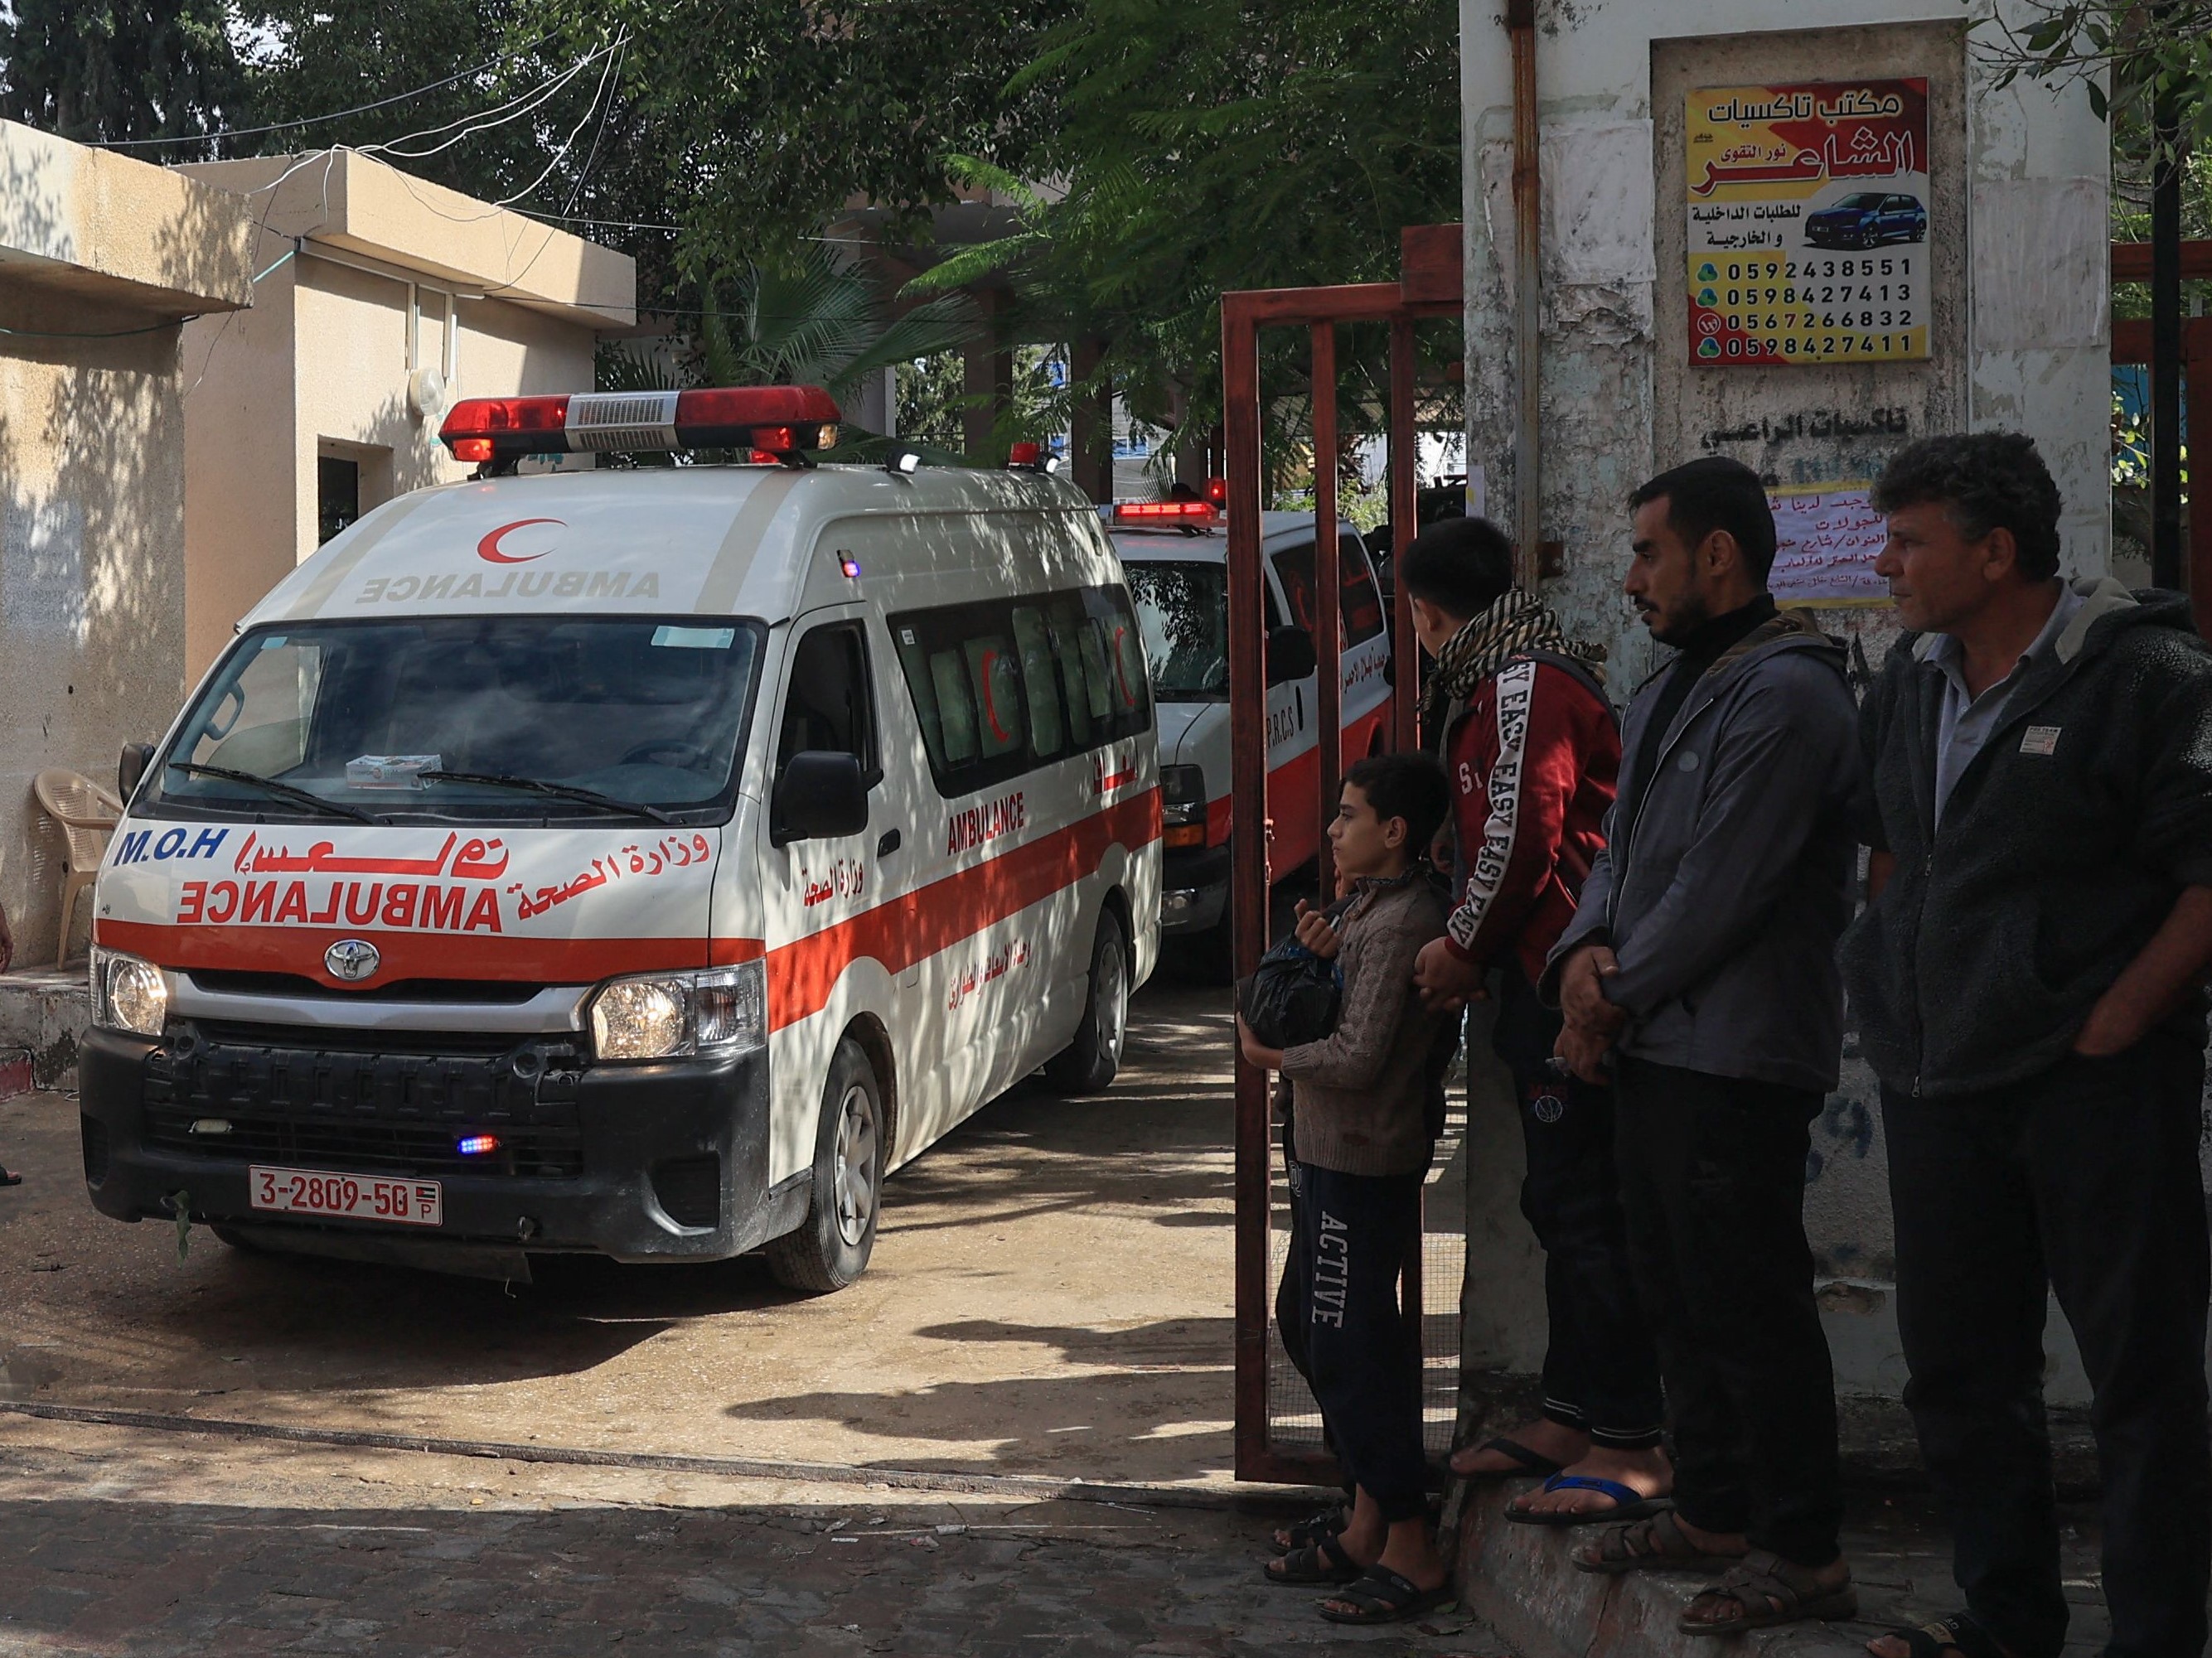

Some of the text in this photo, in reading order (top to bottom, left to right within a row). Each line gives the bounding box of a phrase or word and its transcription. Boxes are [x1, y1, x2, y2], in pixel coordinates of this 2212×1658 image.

[1708, 92, 1900, 128] مكتب تاكسيات
[1690, 126, 1914, 197] الشاعر
[1721, 143, 1786, 163] نور التقوى
[1693, 205, 1801, 221] للطلبات الداخلية
[1727, 259, 1911, 280] 0592438551
[1726, 284, 1911, 306] 0598427413
[1726, 311, 1912, 331] 0567266832
[1726, 336, 1910, 356] 0598427411
[1490, 761, 1517, 828] EASY
[947, 792, 1024, 856] AMBULANCE
[113, 829, 229, 867] M.O.H
[1474, 834, 1510, 892] EASY
[506, 834, 709, 921] وزارة الصحة
[801, 857, 864, 907] وزارة الصحة
[259, 1172, 432, 1219] 3-2809-50 P
[1311, 1211, 1348, 1328] ACTIVE
